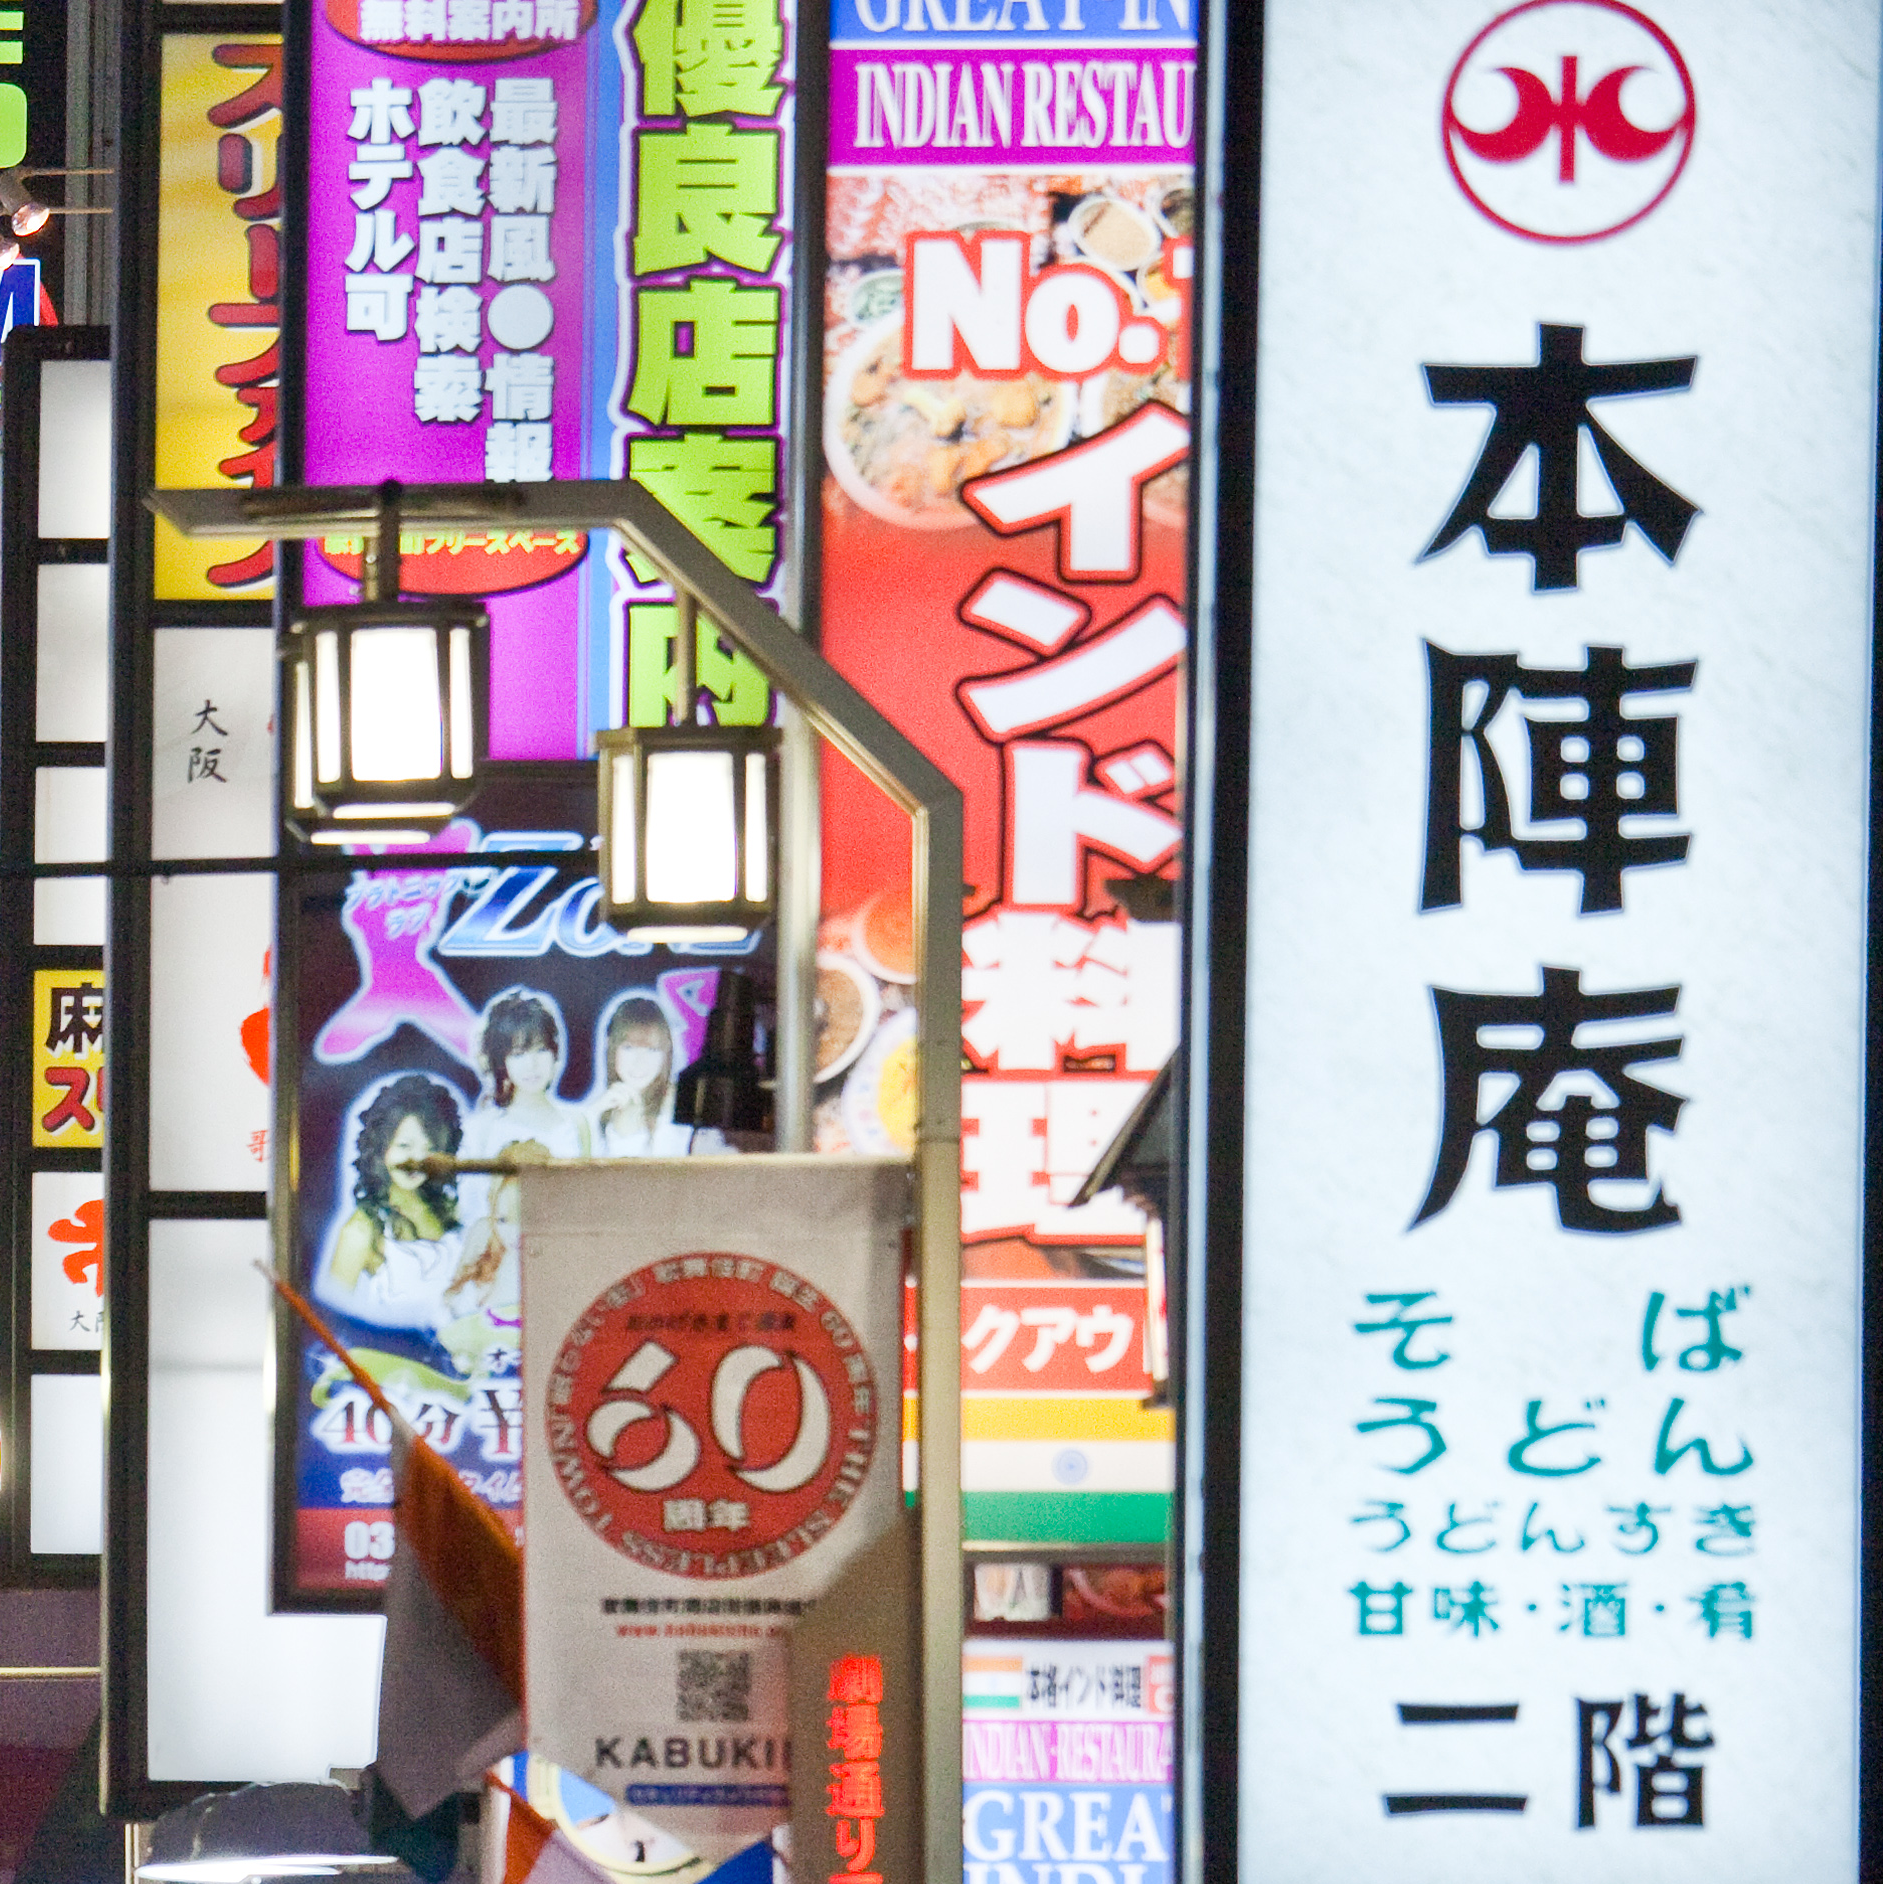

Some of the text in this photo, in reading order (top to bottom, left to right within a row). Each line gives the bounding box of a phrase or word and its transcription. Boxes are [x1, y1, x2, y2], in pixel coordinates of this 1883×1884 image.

[853, 64, 1017, 150] INDIAN
[344, 77, 416, 343] ホテル可
[412, 77, 486, 424] 飲食店検索
[186, 698, 228, 785] 大阪
[1406, 320, 1704, 1238] 本陣庵
[1352, 1287, 1754, 1374] そば
[585, 1340, 831, 1494] 60
[1354, 1398, 1756, 1479] うどん
[1347, 1499, 1758, 1557] うどんすき
[1346, 1579, 1758, 1642] 甘味・酒・肴
[1383, 1691, 1718, 1833] 二階
